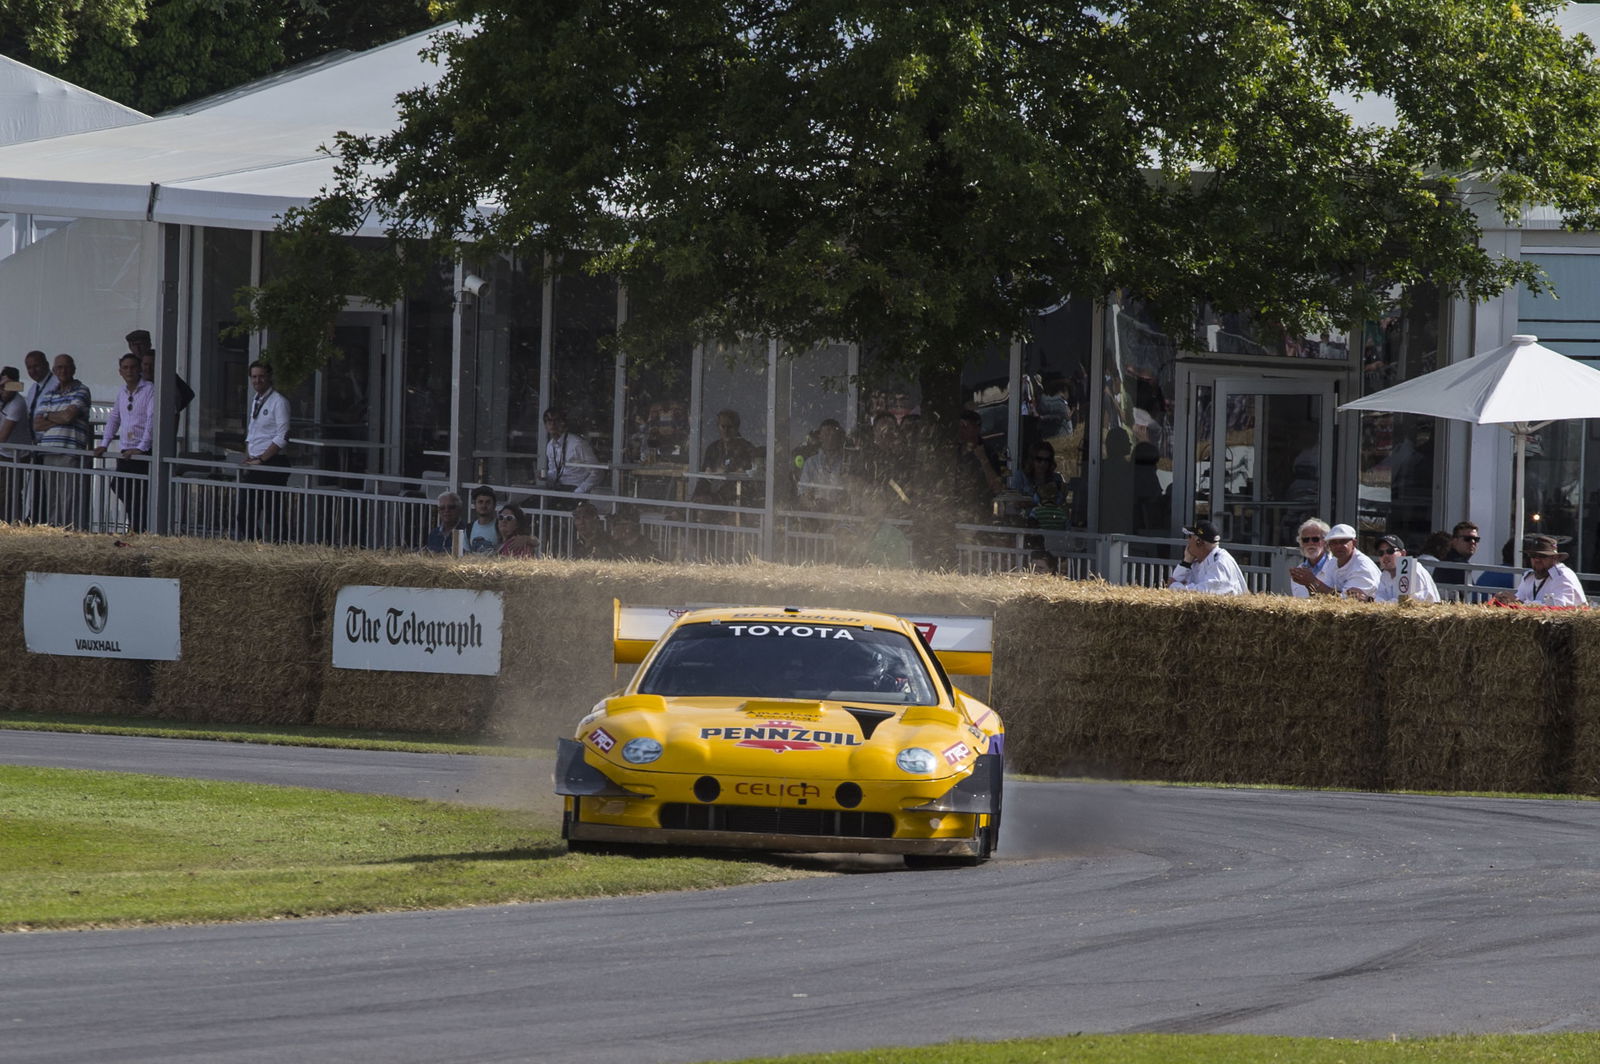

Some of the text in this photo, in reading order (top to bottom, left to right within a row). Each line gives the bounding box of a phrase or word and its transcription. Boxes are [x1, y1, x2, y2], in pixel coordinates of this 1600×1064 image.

[1401, 558, 1408, 574] 2
[345, 605, 483, 656] The Telegraph
[728, 625, 855, 641] TOYOTA
[74, 638, 122, 652] VAUXHALL
[591, 728, 615, 751] TRD
[700, 727, 864, 746] PENNZOIL
[943, 742, 970, 762] TRD
[735, 782, 820, 798] CELICA
